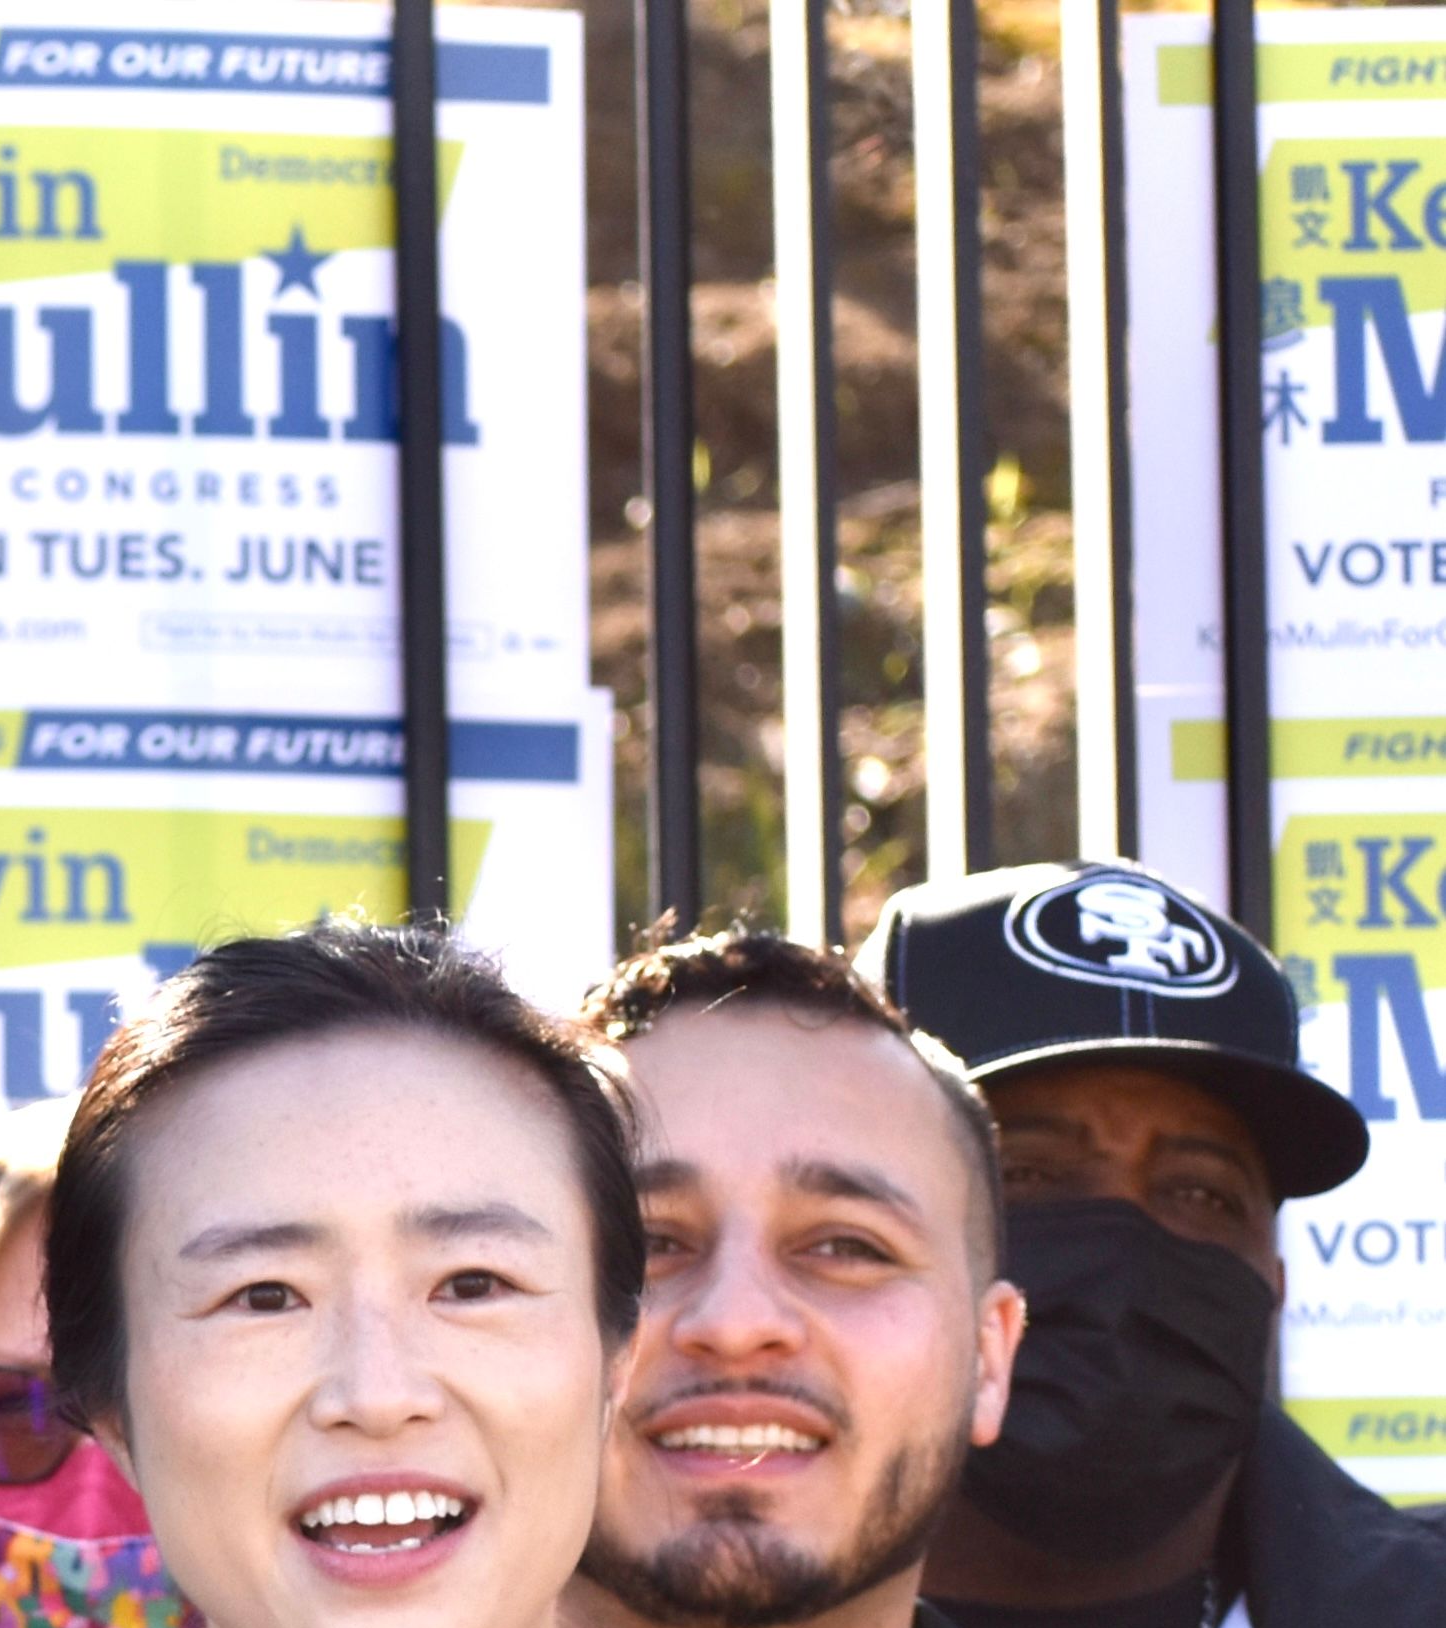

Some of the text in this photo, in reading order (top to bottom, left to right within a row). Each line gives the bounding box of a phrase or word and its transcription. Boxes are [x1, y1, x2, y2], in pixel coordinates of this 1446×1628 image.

[4, 40, 101, 77] FOR
[109, 42, 212, 79] OUR
[219, 46, 392, 87] FUTURE
[220, 146, 392, 188] Democr
[12, 468, 344, 509] CONGRESS
[36, 531, 204, 582] TUES.
[225, 536, 388, 587] JUNE
[30, 722, 130, 760] FOR
[137, 724, 239, 762] OUR
[245, 727, 406, 768] FUTUR
